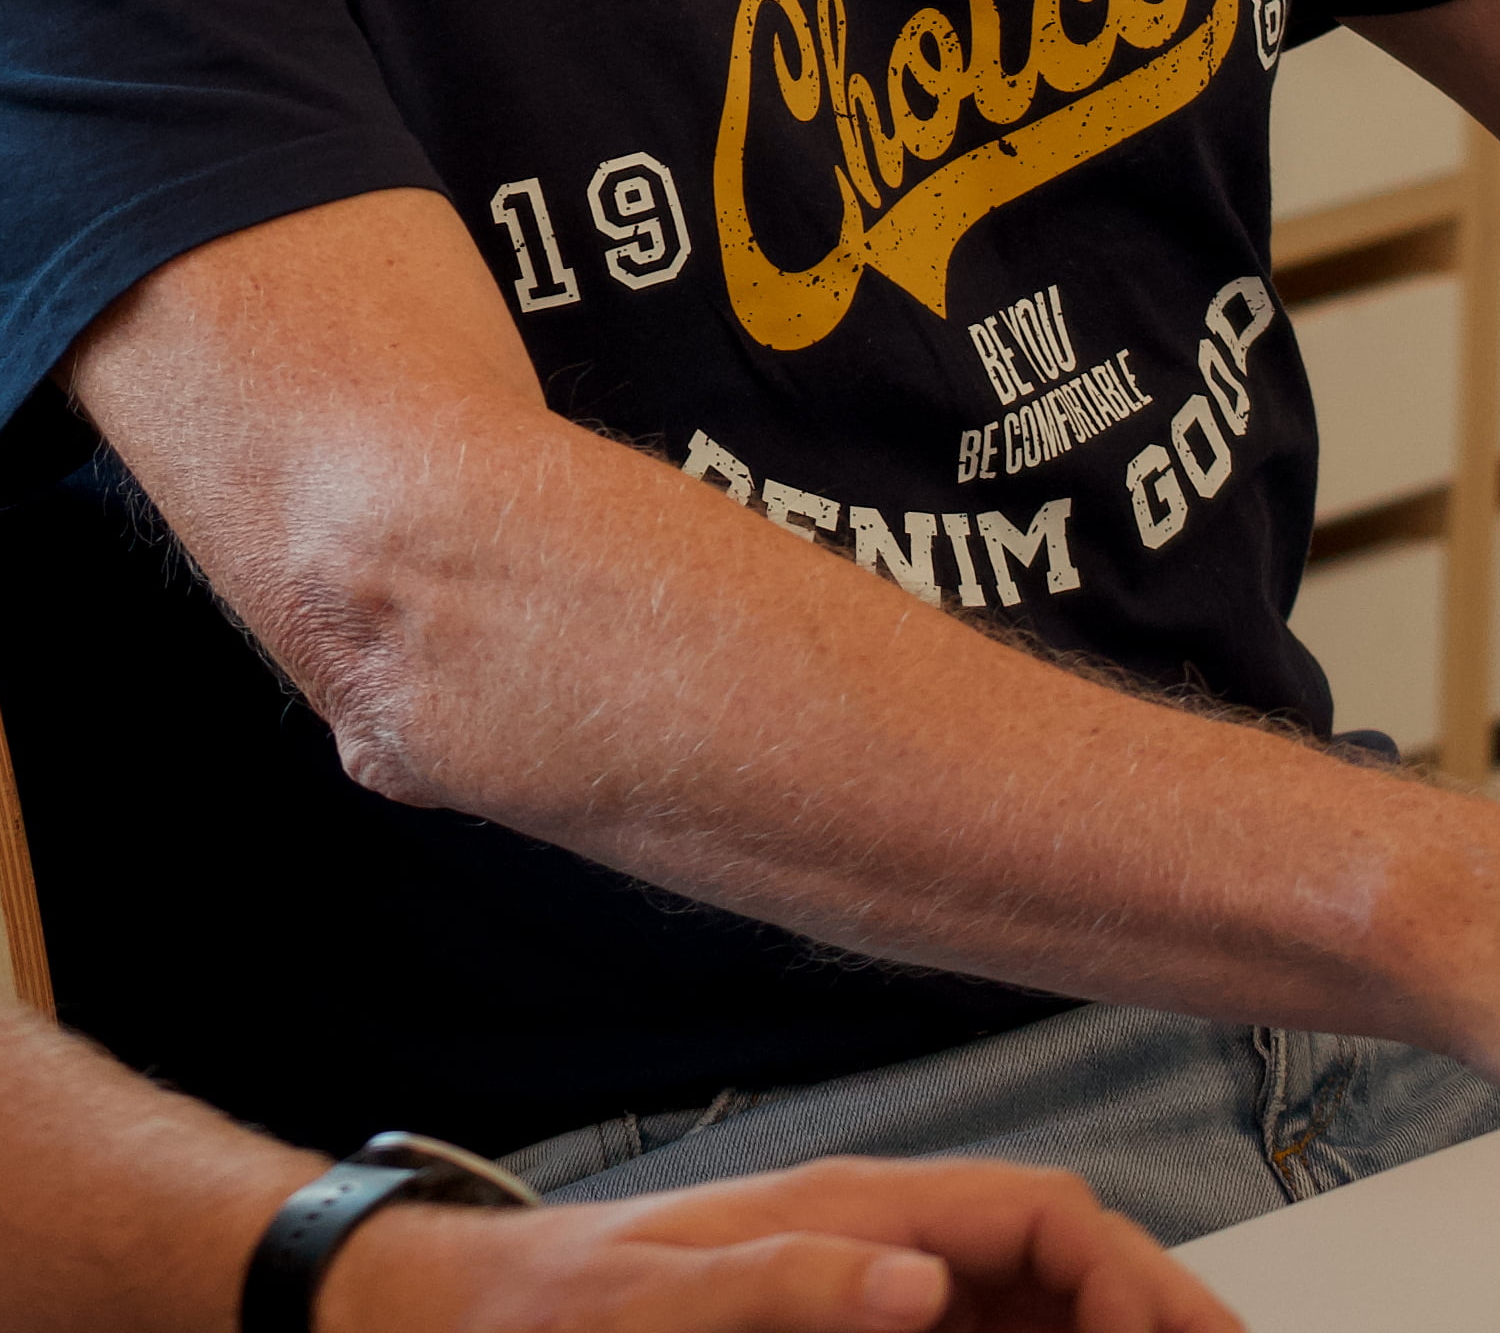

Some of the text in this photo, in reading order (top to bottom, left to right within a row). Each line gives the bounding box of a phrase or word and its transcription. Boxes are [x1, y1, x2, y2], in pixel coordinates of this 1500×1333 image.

[490, 151, 692, 313] 19
[967, 284, 1077, 406] BE YOU
[957, 348, 1154, 484] BE COMFORTABLE
